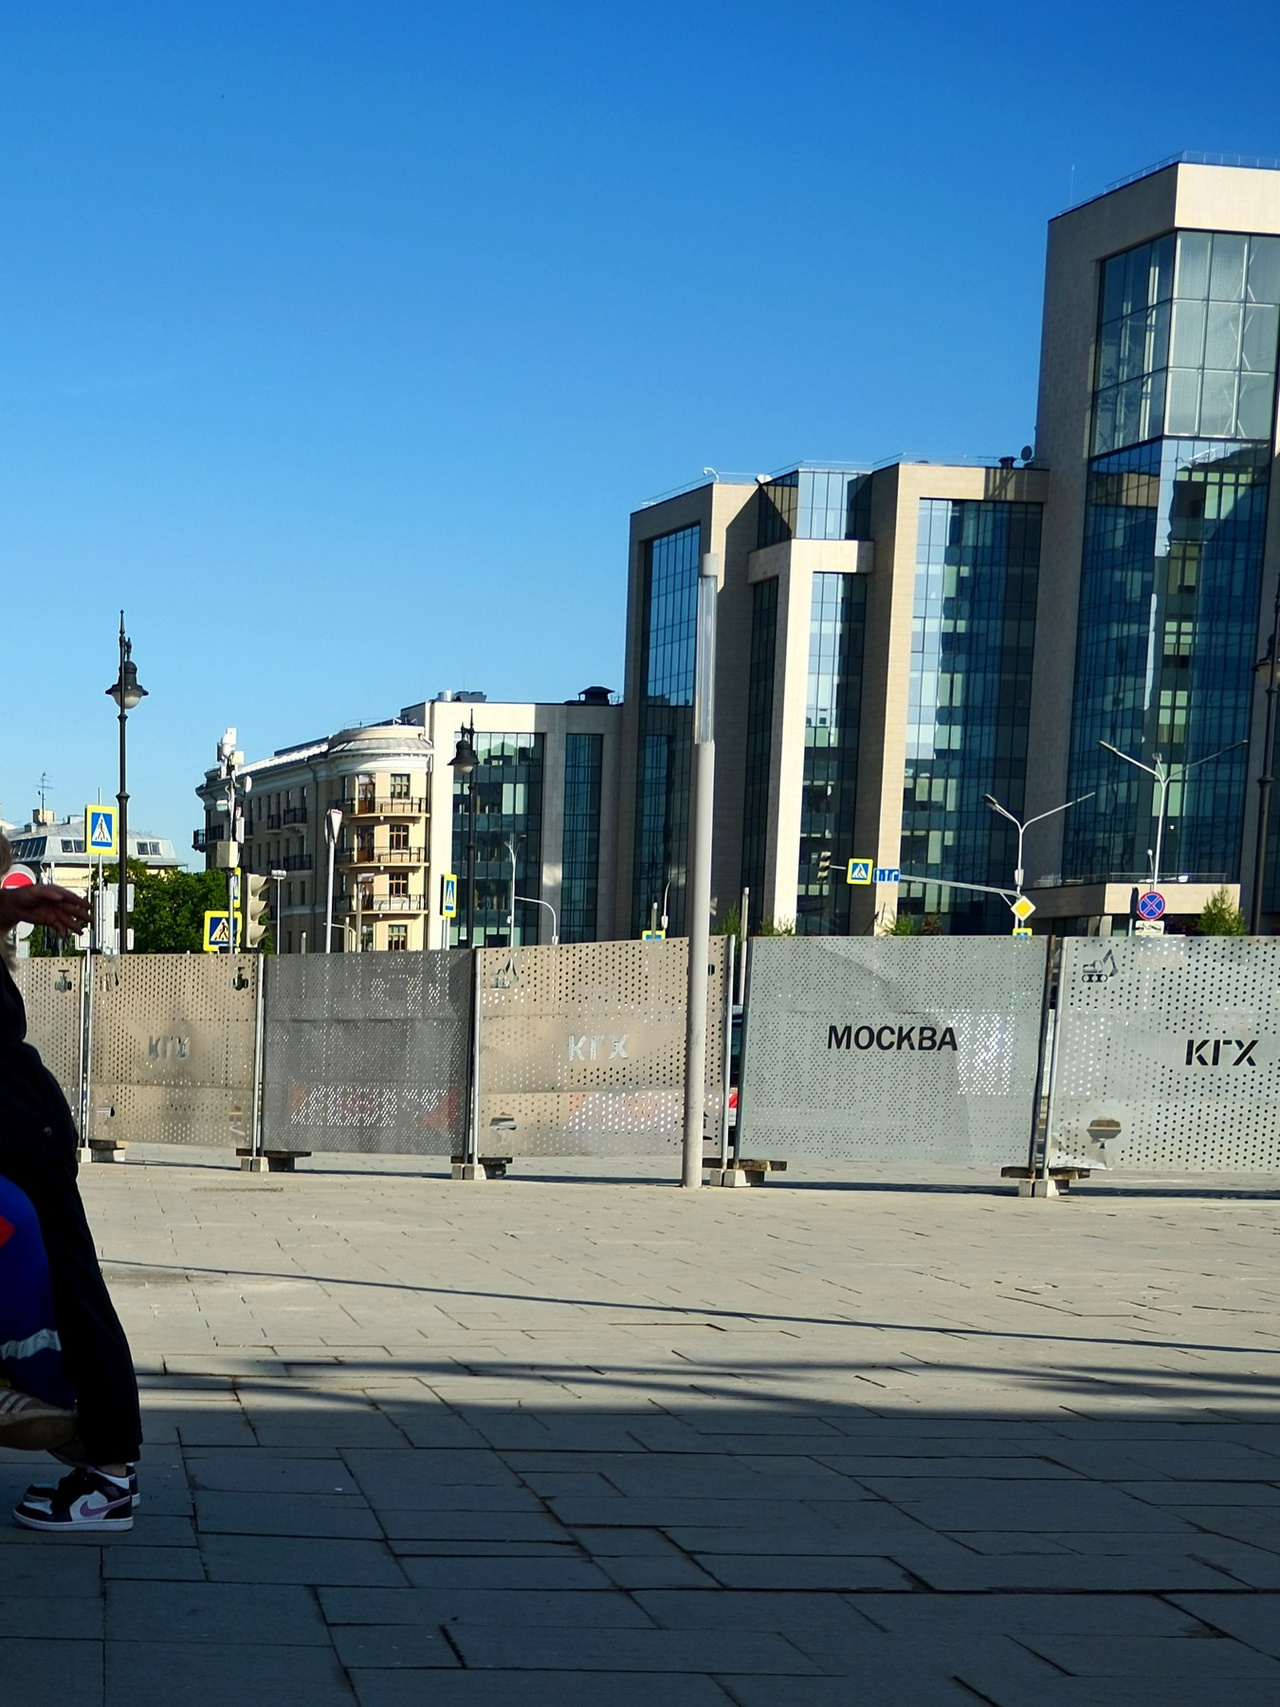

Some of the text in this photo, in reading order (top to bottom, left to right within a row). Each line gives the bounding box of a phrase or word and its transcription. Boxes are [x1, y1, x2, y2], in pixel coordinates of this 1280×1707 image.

[568, 1034, 629, 1061] КГХ
[827, 1025, 959, 1051] МОСКВА
[1185, 1039, 1259, 1067] КГХ
